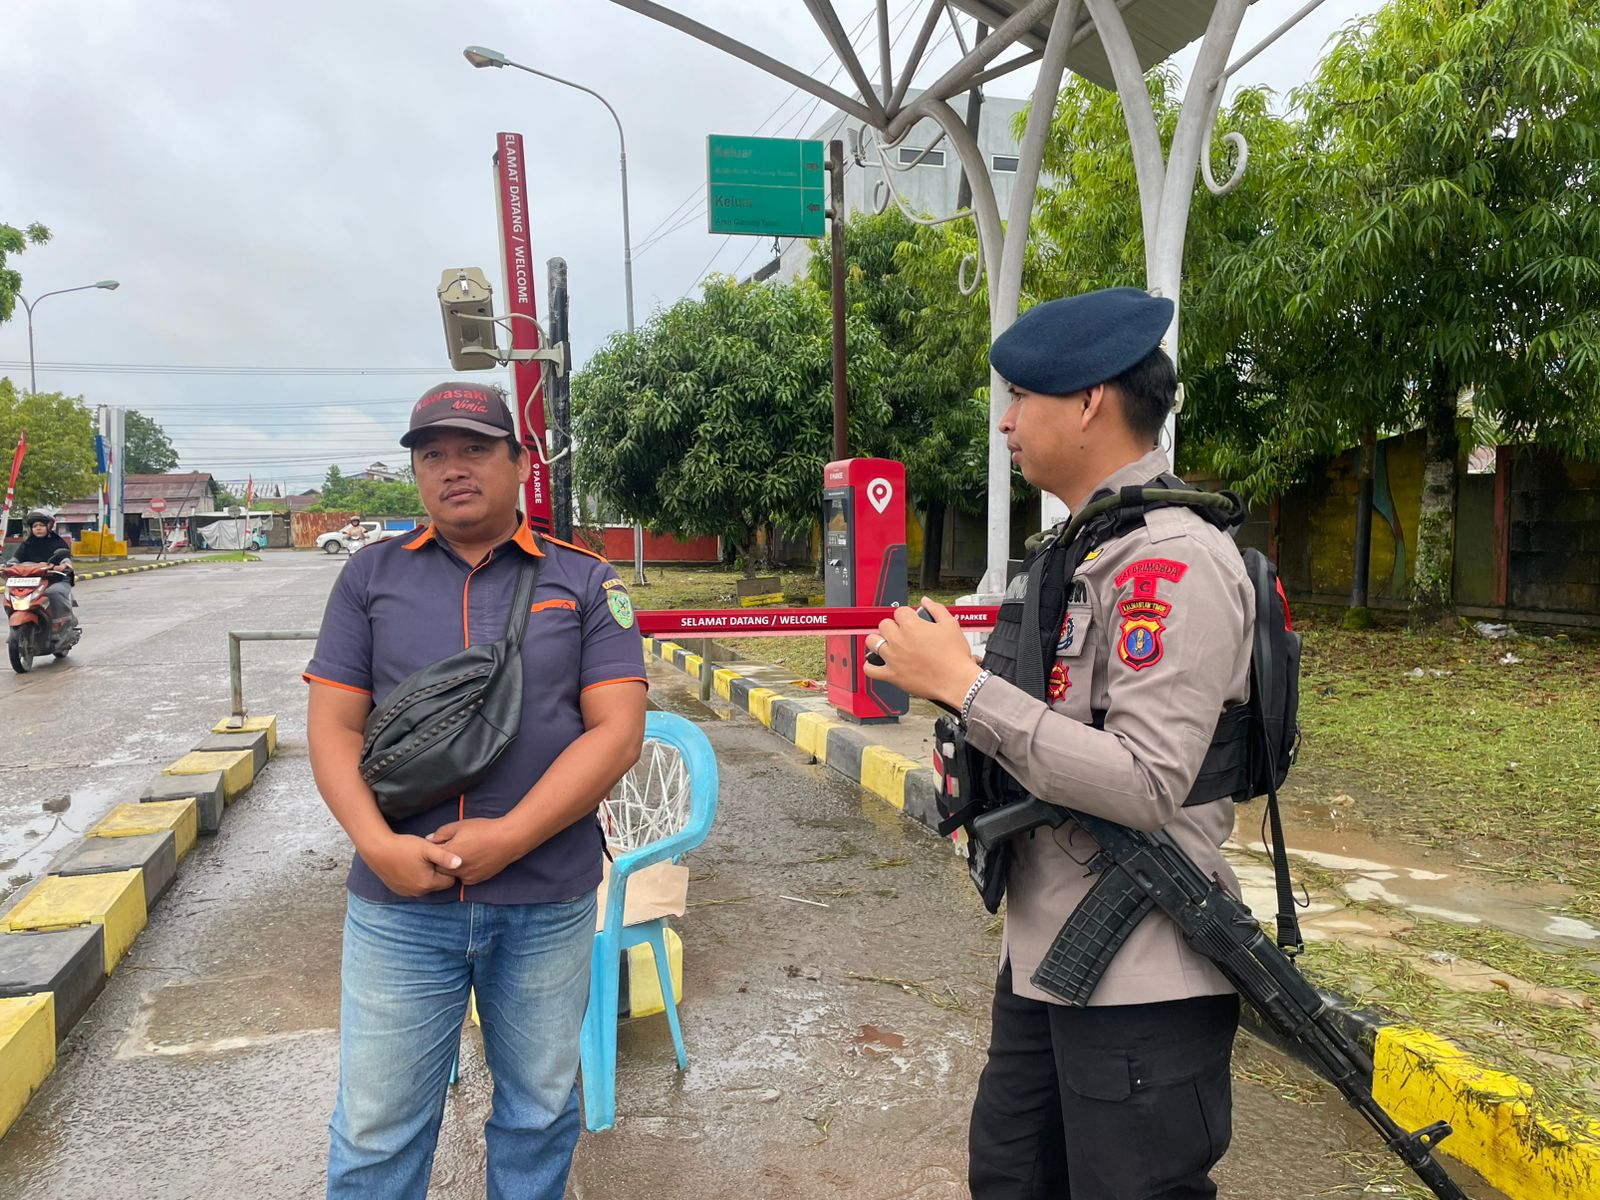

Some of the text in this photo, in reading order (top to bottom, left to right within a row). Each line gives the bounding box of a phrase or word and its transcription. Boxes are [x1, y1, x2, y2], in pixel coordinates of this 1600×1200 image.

[715, 195, 752, 208] Keluar
[510, 186, 523, 233] DATANG
[515, 246, 528, 304] WELCOME
[415, 389, 488, 413] Kawasaki
[452, 399, 488, 413] Ninja
[533, 470, 542, 504] PARKEE
[1132, 563, 1179, 577] BRIMOBDA
[1139, 580, 1152, 593] C
[681, 615, 828, 627] SELAMAT DATANG / WELCOME
